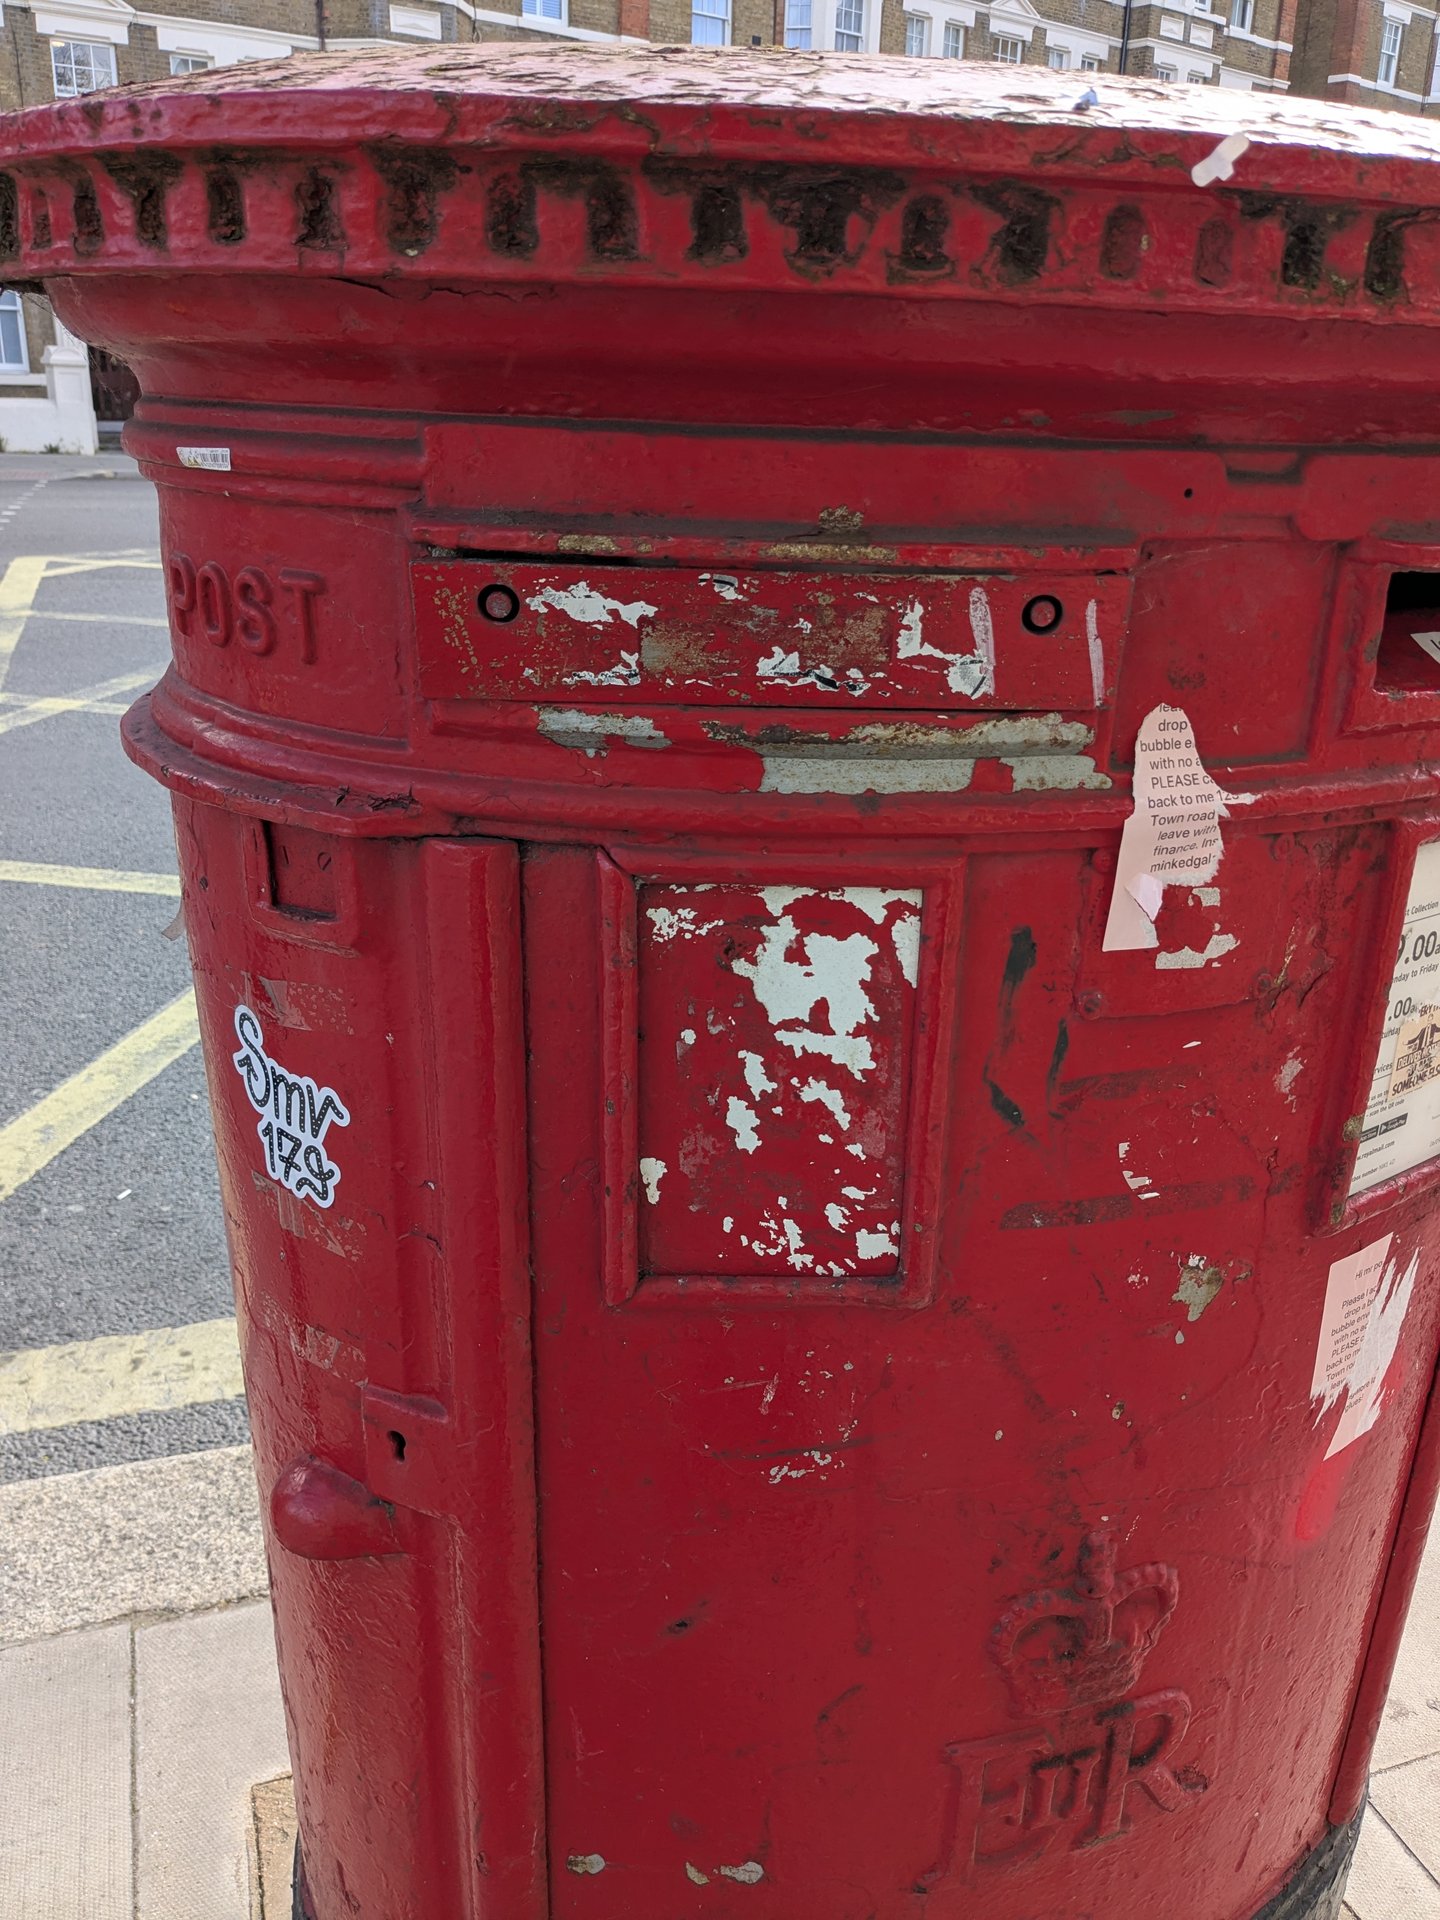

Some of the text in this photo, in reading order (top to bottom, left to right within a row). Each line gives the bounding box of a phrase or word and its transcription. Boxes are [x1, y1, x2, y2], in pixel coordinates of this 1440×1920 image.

[169, 553, 327, 665] POST
[1158, 719, 1188, 733] drop
[1140, 738, 1193, 753] bubble e
[1149, 757, 1175, 770] with
[1178, 758, 1192, 768] no
[1151, 773, 1200, 789] PLEASE
[1148, 794, 1178, 809] back
[1180, 794, 1193, 805] to
[1195, 793, 1215, 804] me
[1151, 809, 1216, 826] Town road
[1157, 825, 1217, 841] leave with
[1153, 842, 1198, 856] finance.
[1150, 853, 1216, 873] minkedgal
[1411, 901, 1439, 914] Collection
[1411, 968, 1418, 977] to
[1419, 963, 1439, 976] Friday
[1341, 1293, 1365, 1310] Please
[1344, 1306, 1361, 1319] drop
[1331, 1319, 1355, 1336] bubble
[1334, 1333, 1349, 1346] with
[1350, 1328, 1359, 1338] no
[1331, 1337, 1360, 1358] PLEASE
[1326, 1358, 1342, 1372] back
[1344, 1353, 1351, 1361] to
[1326, 1367, 1345, 1381] Town
